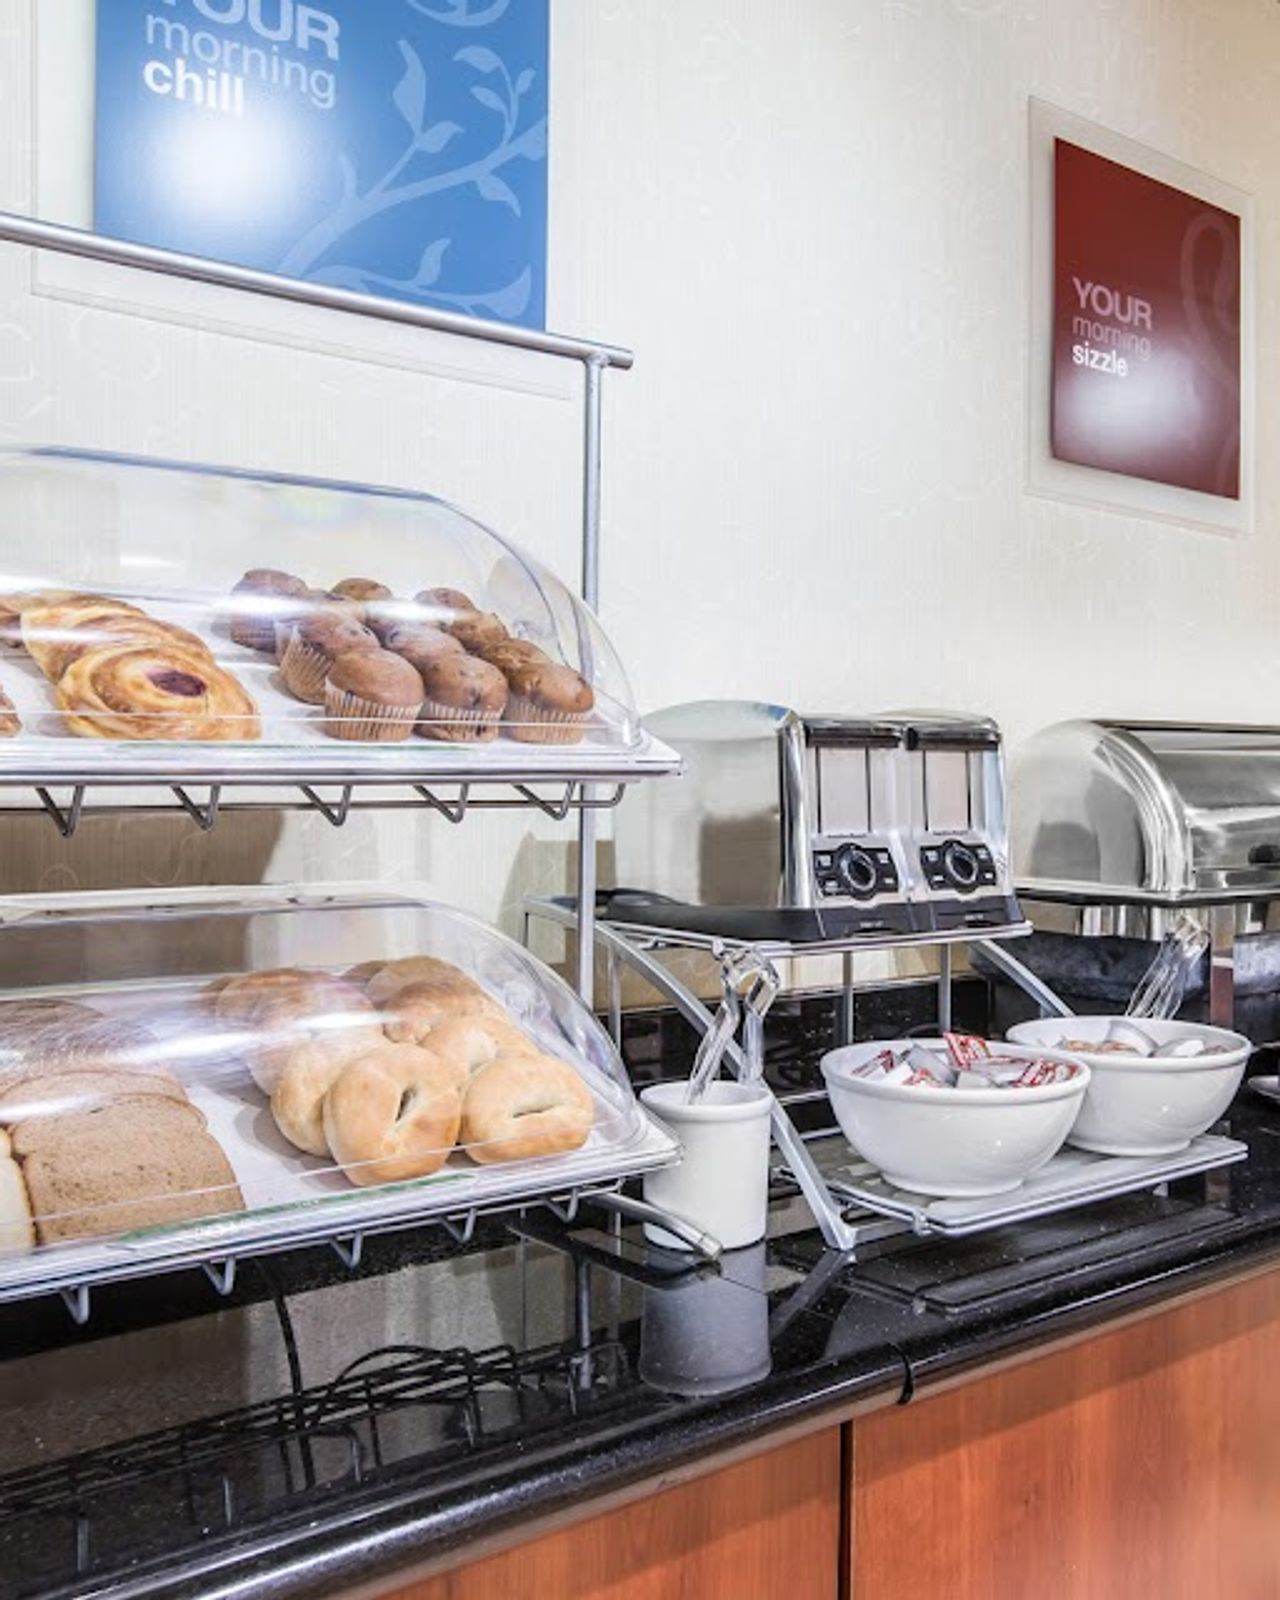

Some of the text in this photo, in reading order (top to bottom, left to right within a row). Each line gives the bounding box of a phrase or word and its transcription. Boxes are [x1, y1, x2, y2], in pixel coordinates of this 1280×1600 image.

[161, 0, 340, 61] UR
[143, 58, 245, 118] chill
[146, 14, 336, 110] morning
[1072, 276, 1152, 331] YOUR
[1072, 316, 1151, 361] morning
[1072, 340, 1128, 377] sizzle
